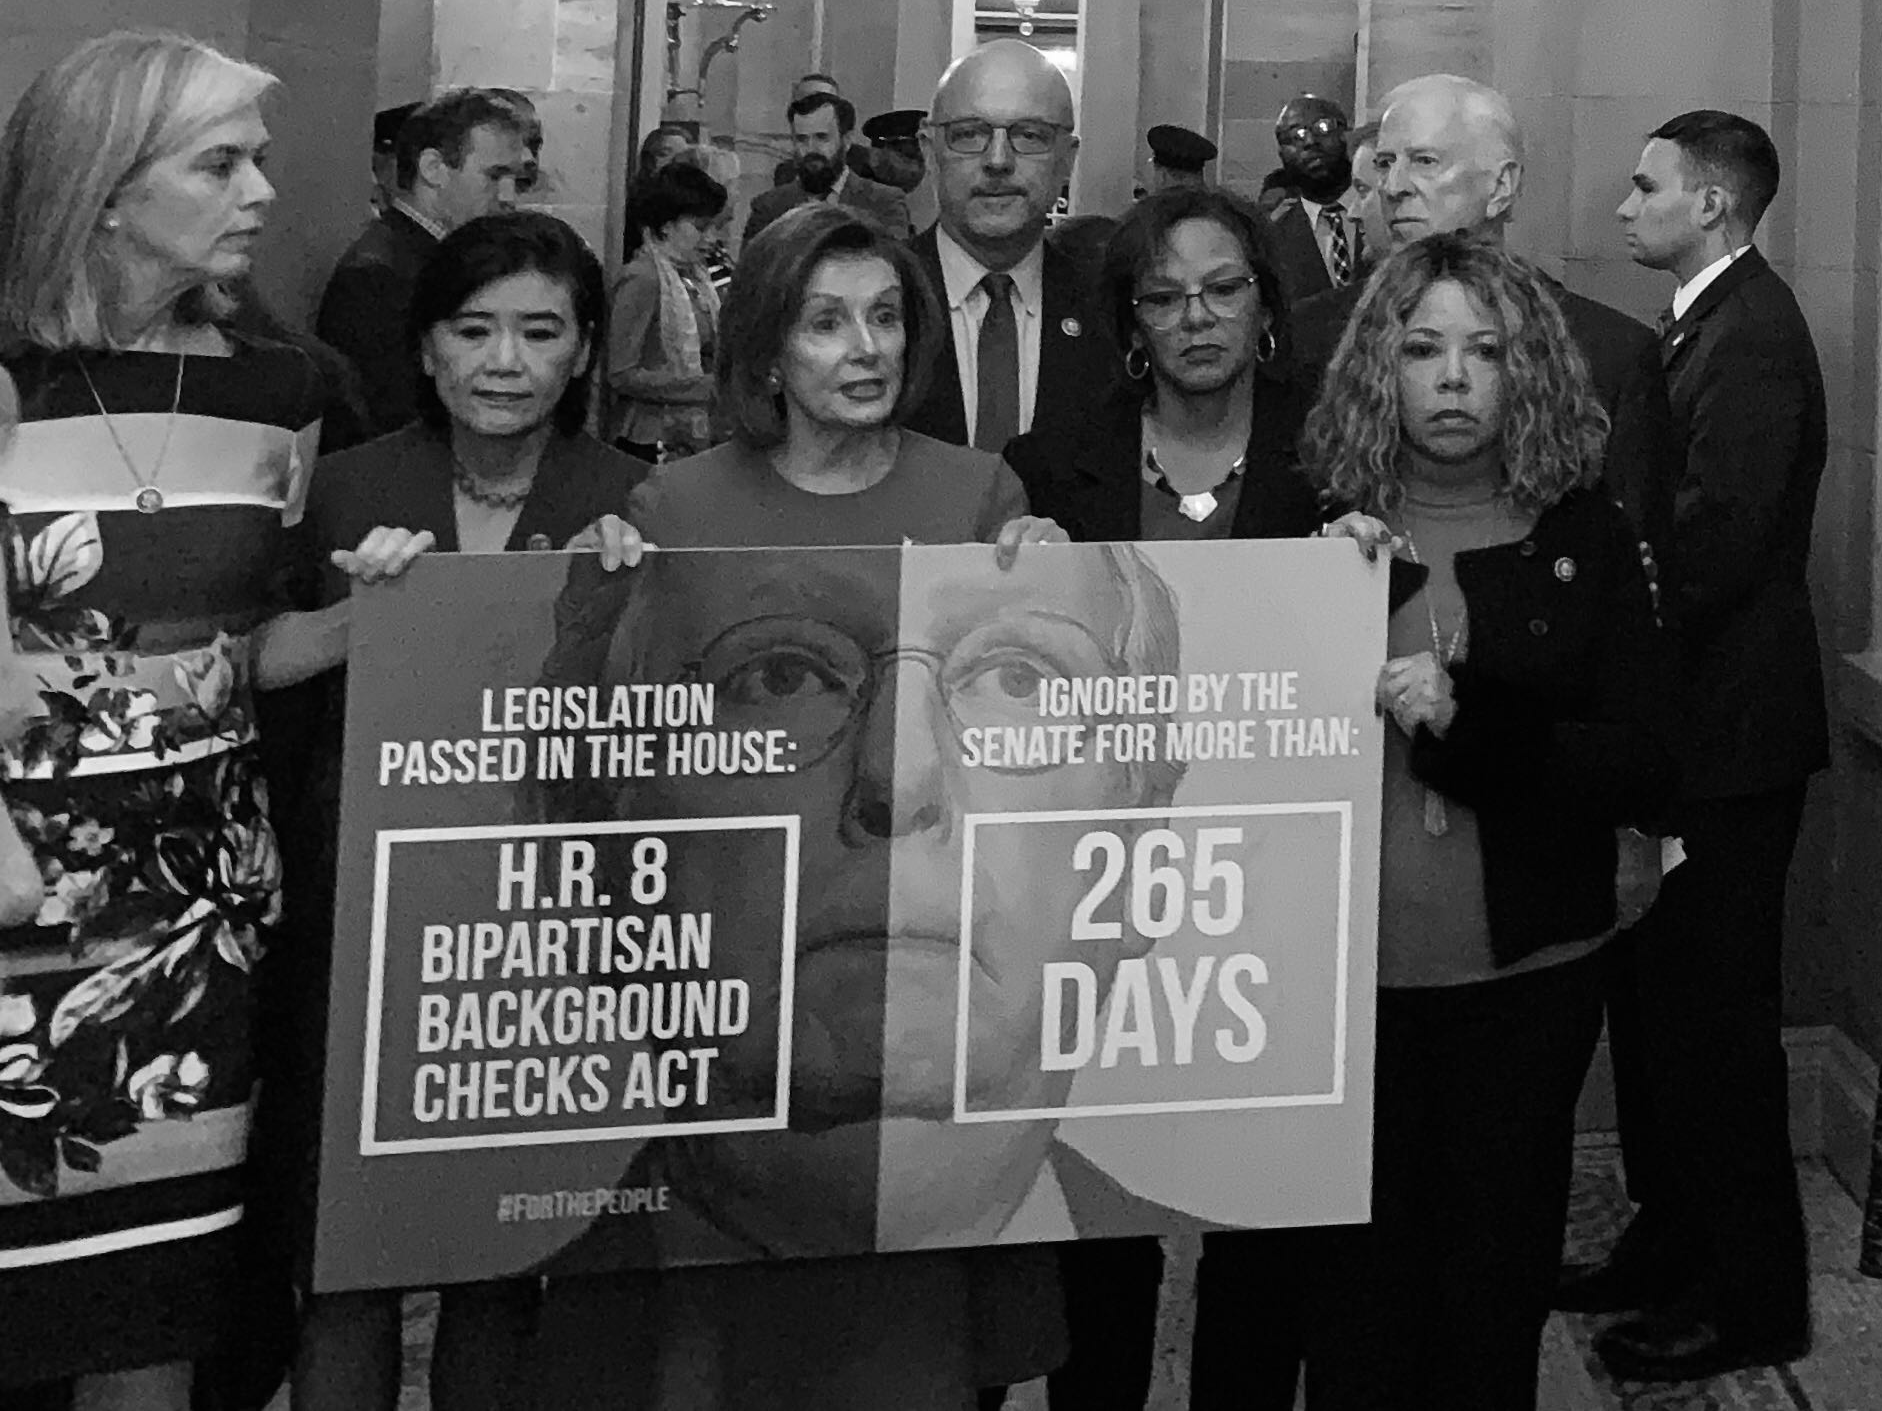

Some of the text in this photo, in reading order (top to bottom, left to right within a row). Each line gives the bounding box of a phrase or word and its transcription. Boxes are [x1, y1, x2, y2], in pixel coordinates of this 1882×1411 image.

[482, 683, 715, 732] LEGISLATION
[1038, 671, 1299, 717] IGNORED BY THE
[379, 729, 798, 787] PASSED IN THE HOUSE:
[961, 716, 1361, 767] SENATE FOR MORE THAN:
[496, 837, 669, 911] H.R. 8
[1071, 826, 1245, 940] 265
[421, 912, 712, 983] BIPARTISAN
[417, 979, 750, 1053] BACKGROUND
[1039, 952, 1269, 1071] DAYS
[413, 1047, 720, 1122] CHECKS ACT
